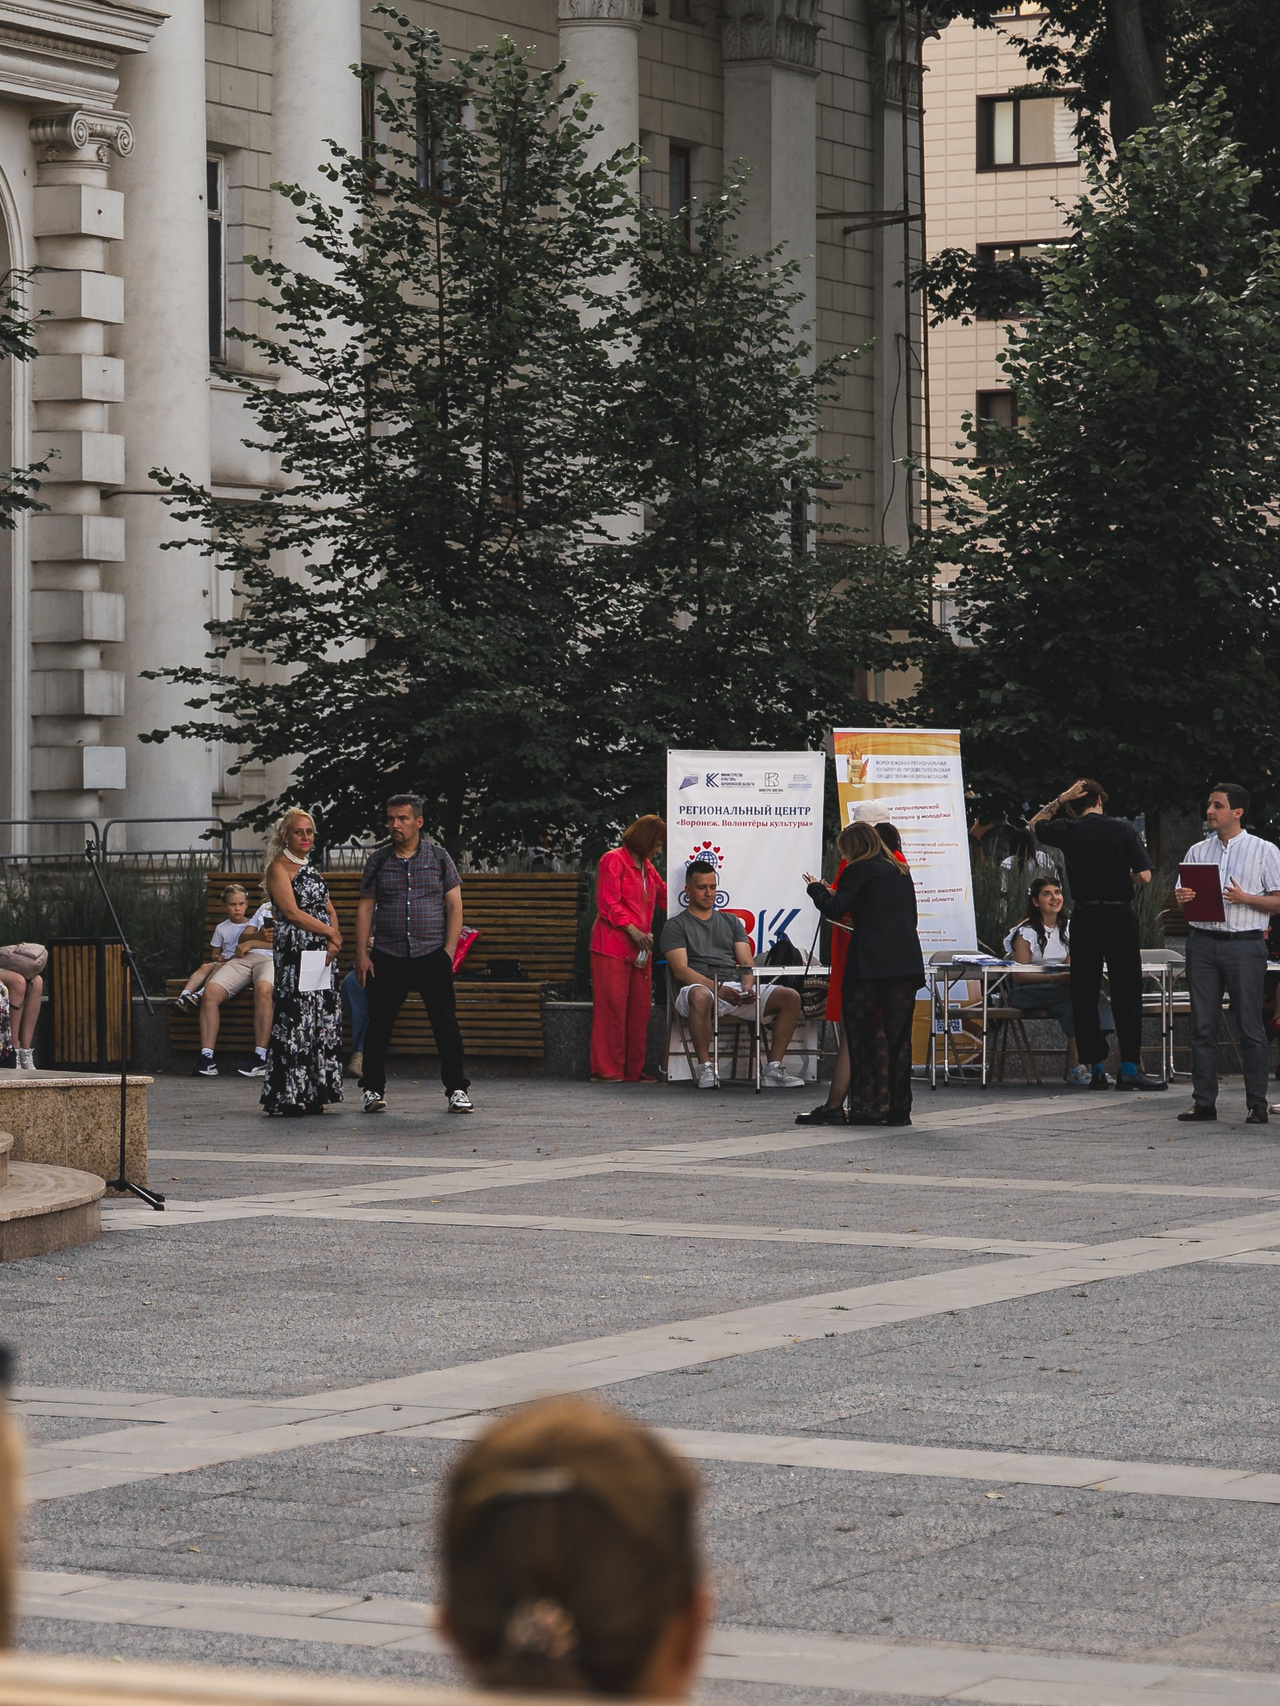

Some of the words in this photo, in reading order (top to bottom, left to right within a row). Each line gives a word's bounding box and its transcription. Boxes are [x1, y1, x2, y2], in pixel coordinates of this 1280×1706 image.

[679, 804, 772, 816] РЕГИОНАЛЬНЫЙ
[774, 806, 812, 817] ЦЕНТР
[721, 819, 768, 829] Волонтёры
